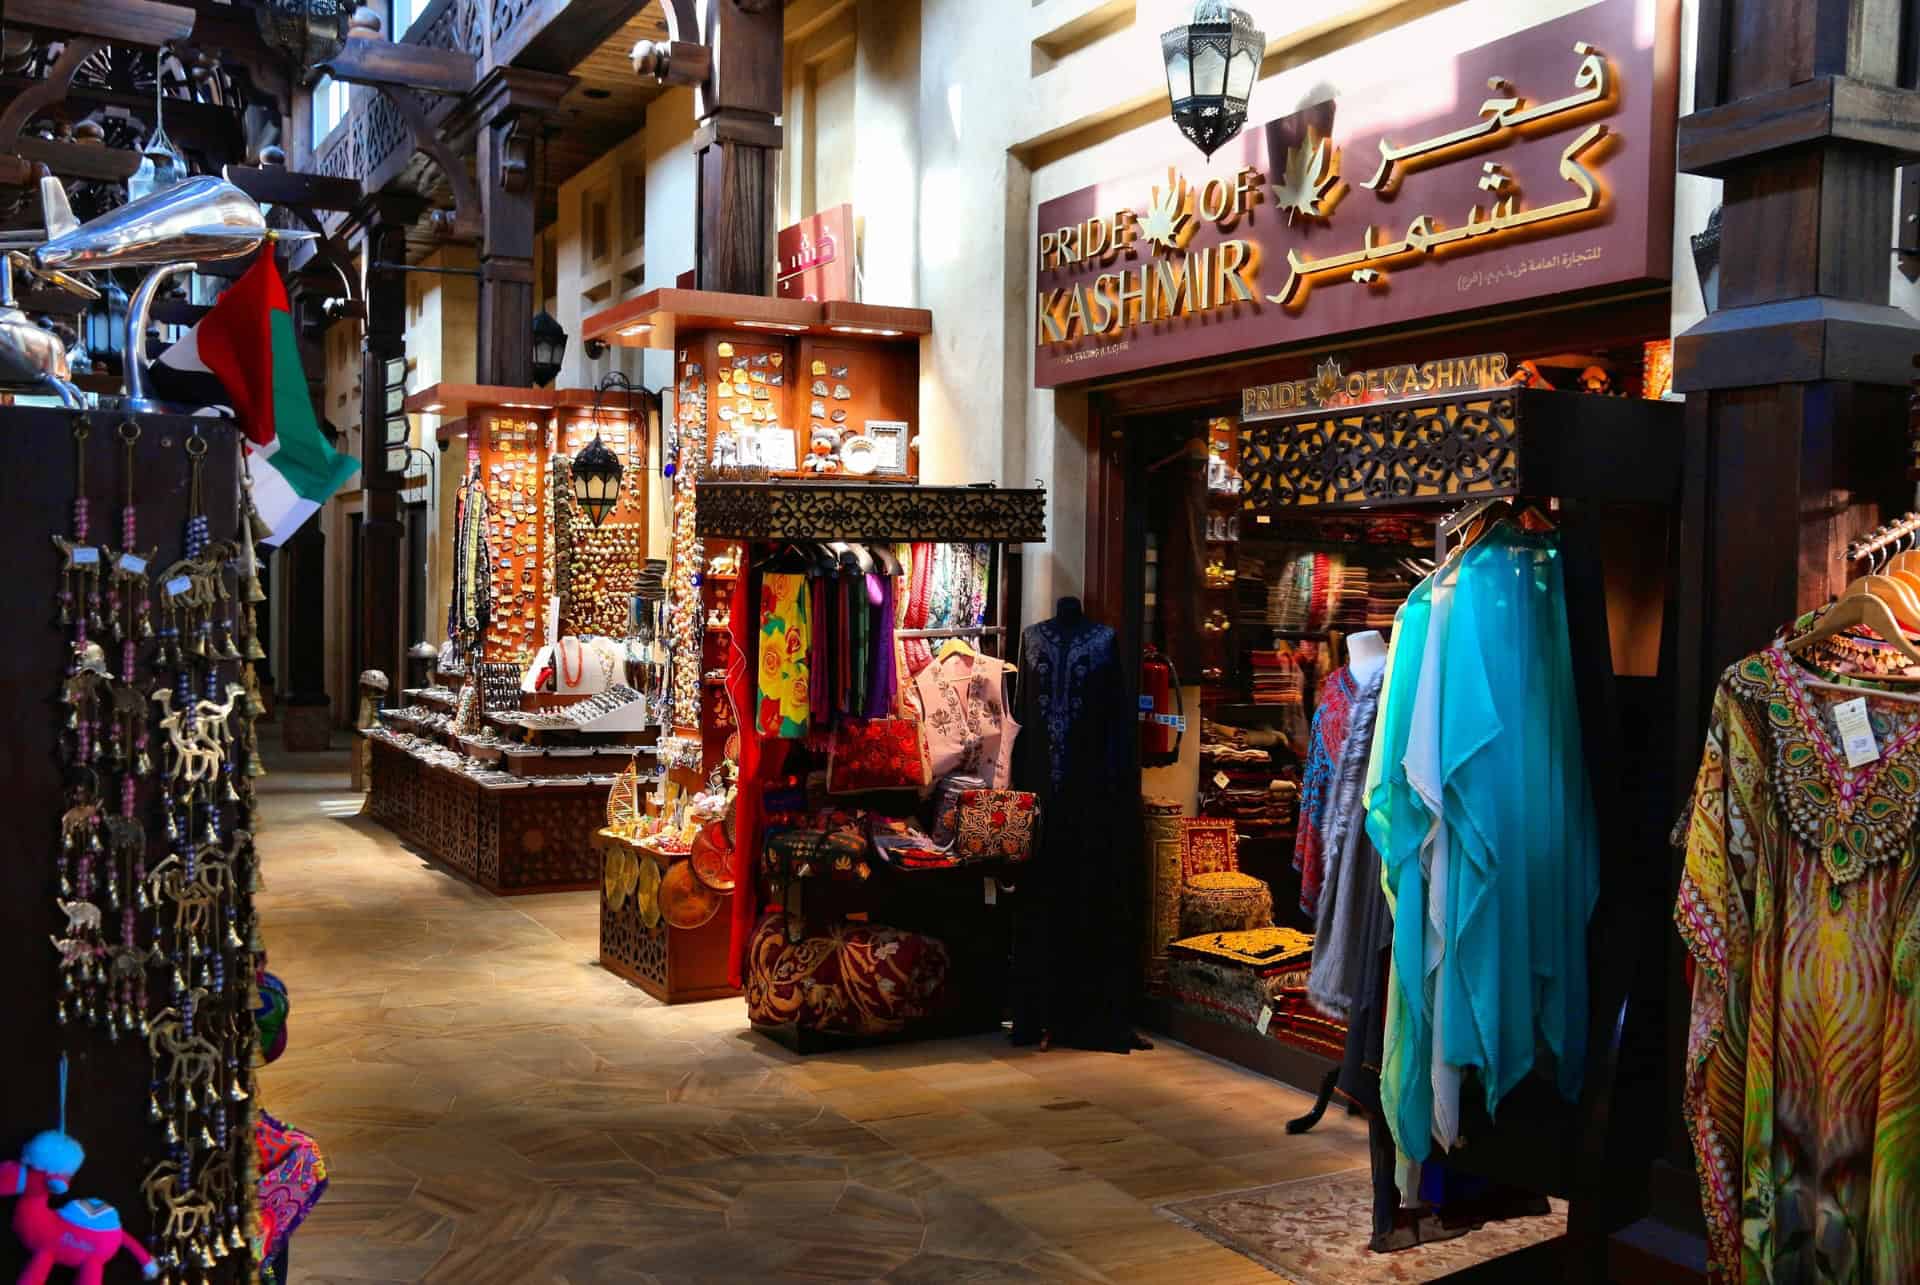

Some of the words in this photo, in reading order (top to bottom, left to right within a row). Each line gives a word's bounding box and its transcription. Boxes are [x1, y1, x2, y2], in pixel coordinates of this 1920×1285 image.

[1360, 41, 1607, 191] فخر
[1040, 208, 1134, 272] PRIDE
[1200, 166, 1262, 222] OF
[1266, 123, 1611, 304] كشمير
[1038, 240, 1254, 345] KASHMIR
[1244, 383, 1308, 414] PRIDE
[1346, 370, 1379, 399] OF
[1383, 354, 1509, 395] KASHMIR
